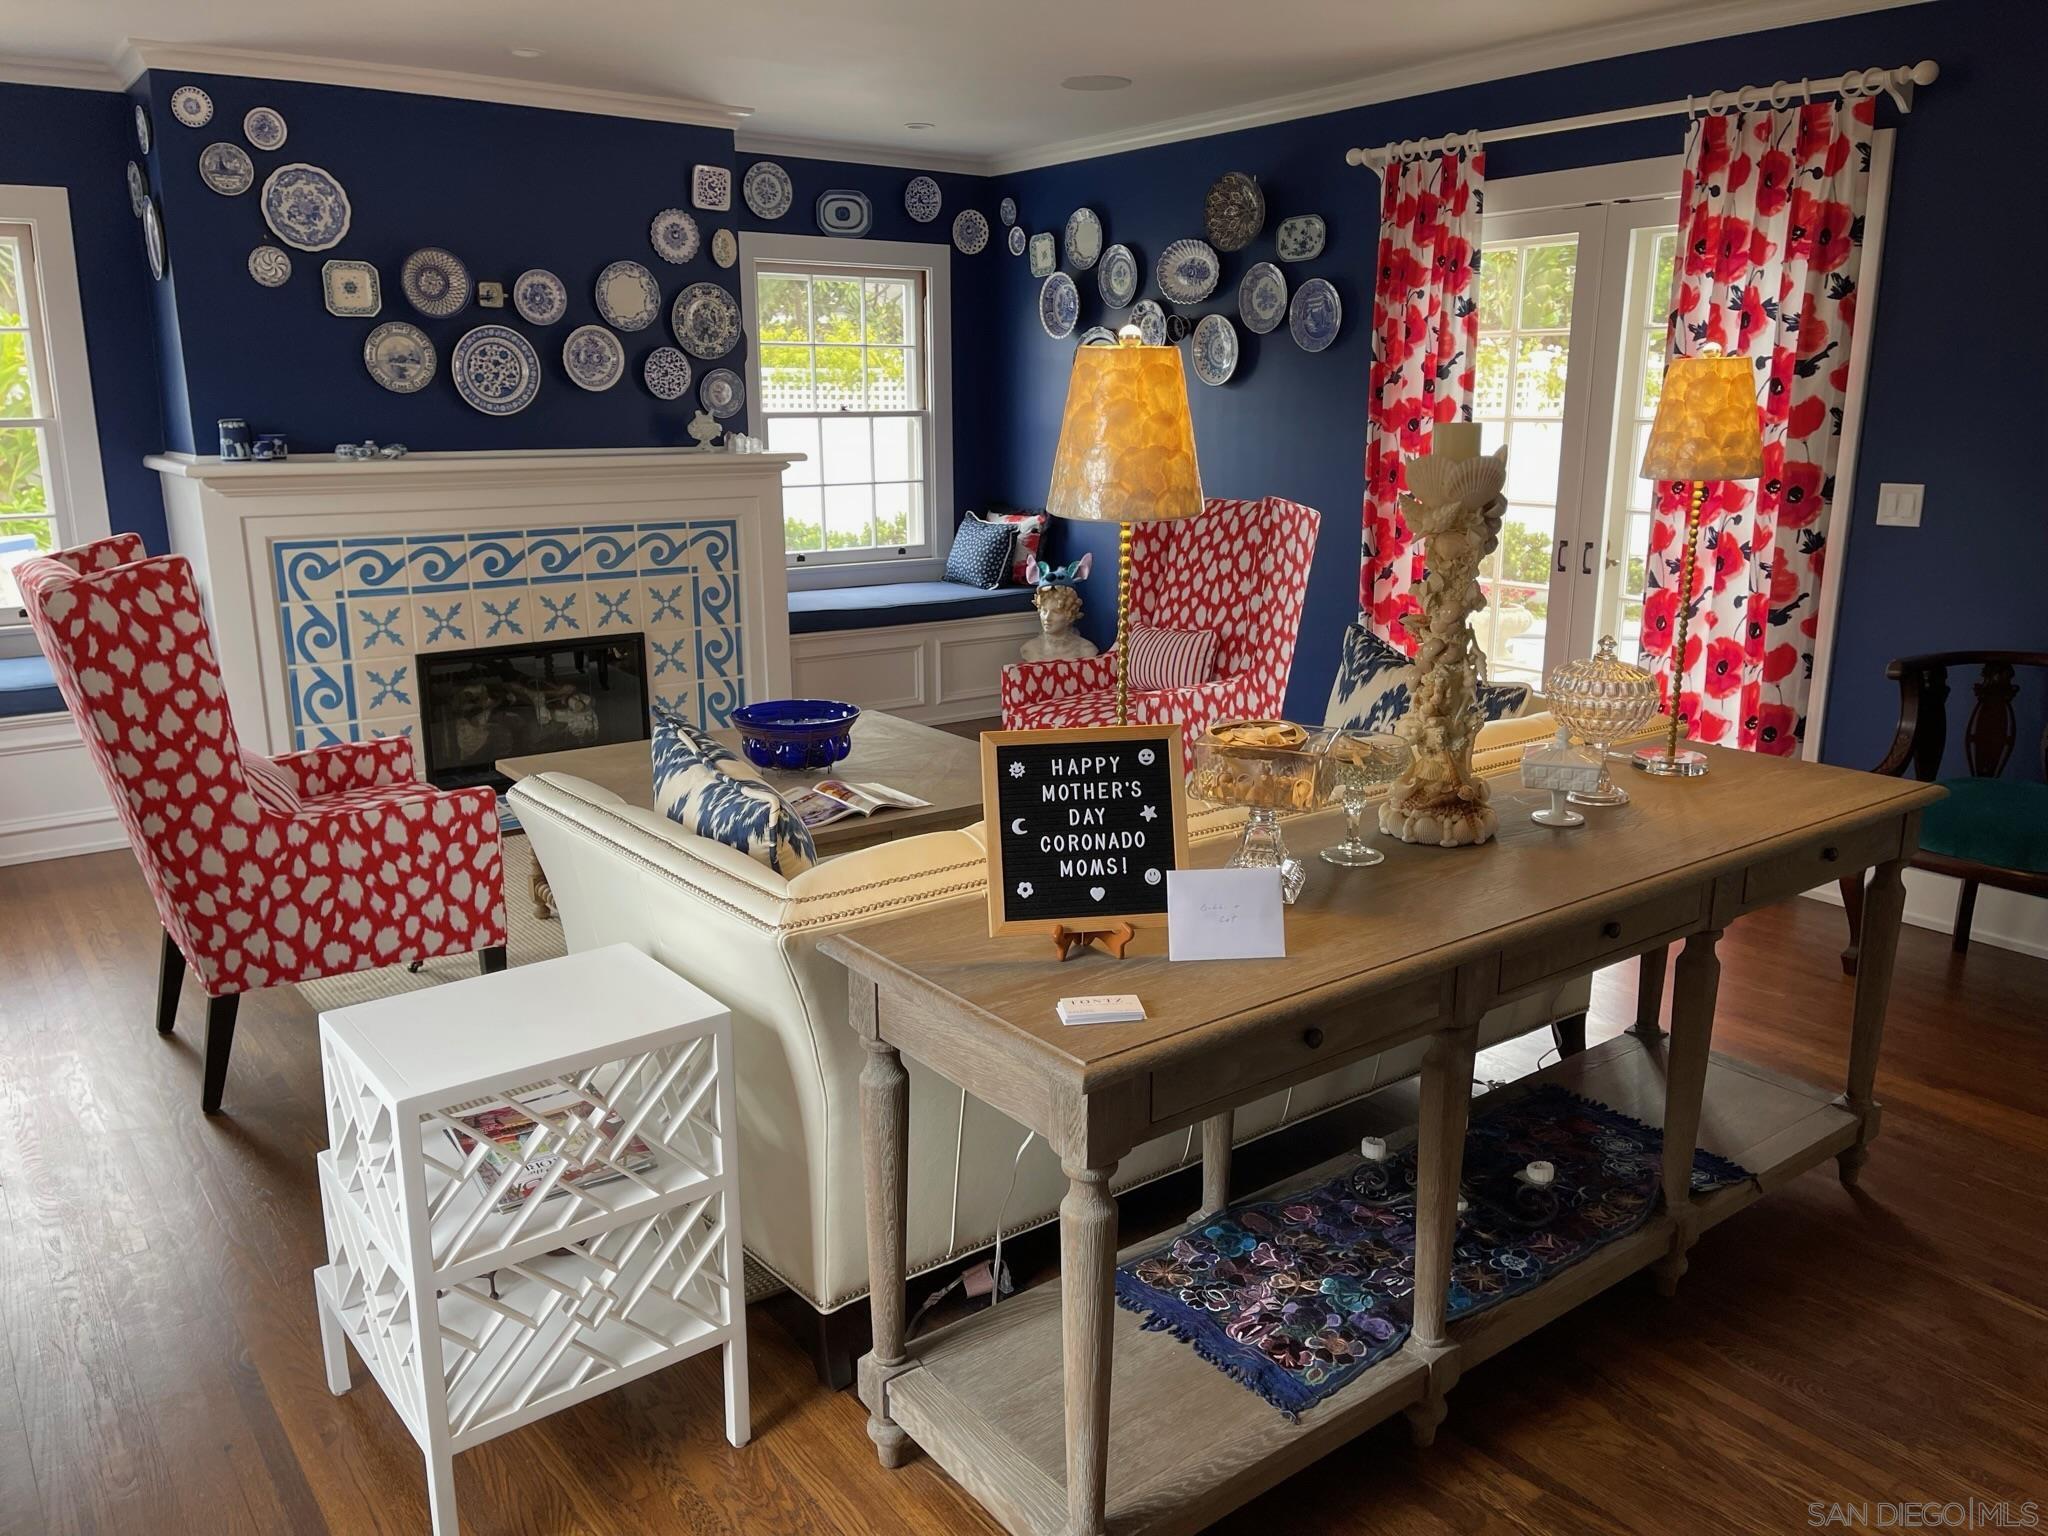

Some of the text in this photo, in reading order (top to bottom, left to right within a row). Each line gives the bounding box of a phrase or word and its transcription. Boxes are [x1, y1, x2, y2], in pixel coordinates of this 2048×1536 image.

[1051, 756, 1120, 776] HAPPY
[1042, 780, 1142, 802] MOTHER'S
[1069, 807, 1105, 826] DAY
[1040, 831, 1146, 853] CORONADO
[1060, 856, 1128, 878] MOMS!
